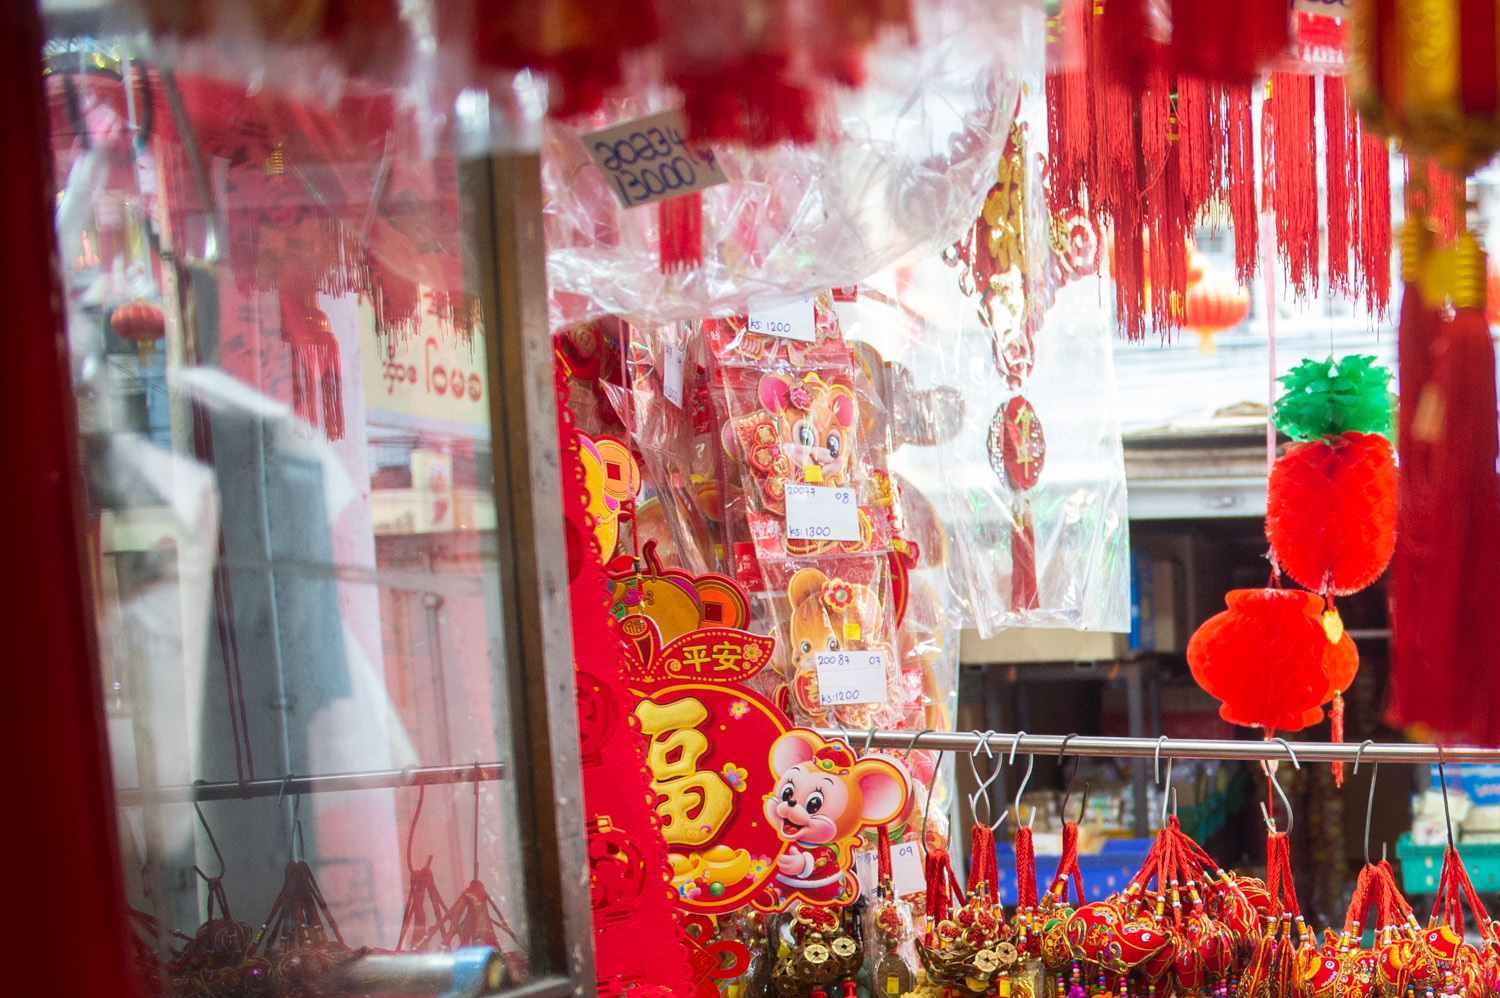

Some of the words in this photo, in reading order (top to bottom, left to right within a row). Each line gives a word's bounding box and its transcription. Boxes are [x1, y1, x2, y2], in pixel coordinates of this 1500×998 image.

[615, 156, 695, 206] 13000
[766, 321, 791, 333] 1200
[835, 492, 849, 504] 08
[805, 526, 831, 537] 1300
[682, 641, 742, 673] 平安
[868, 656, 880, 666] 07
[899, 846, 913, 857] 09
